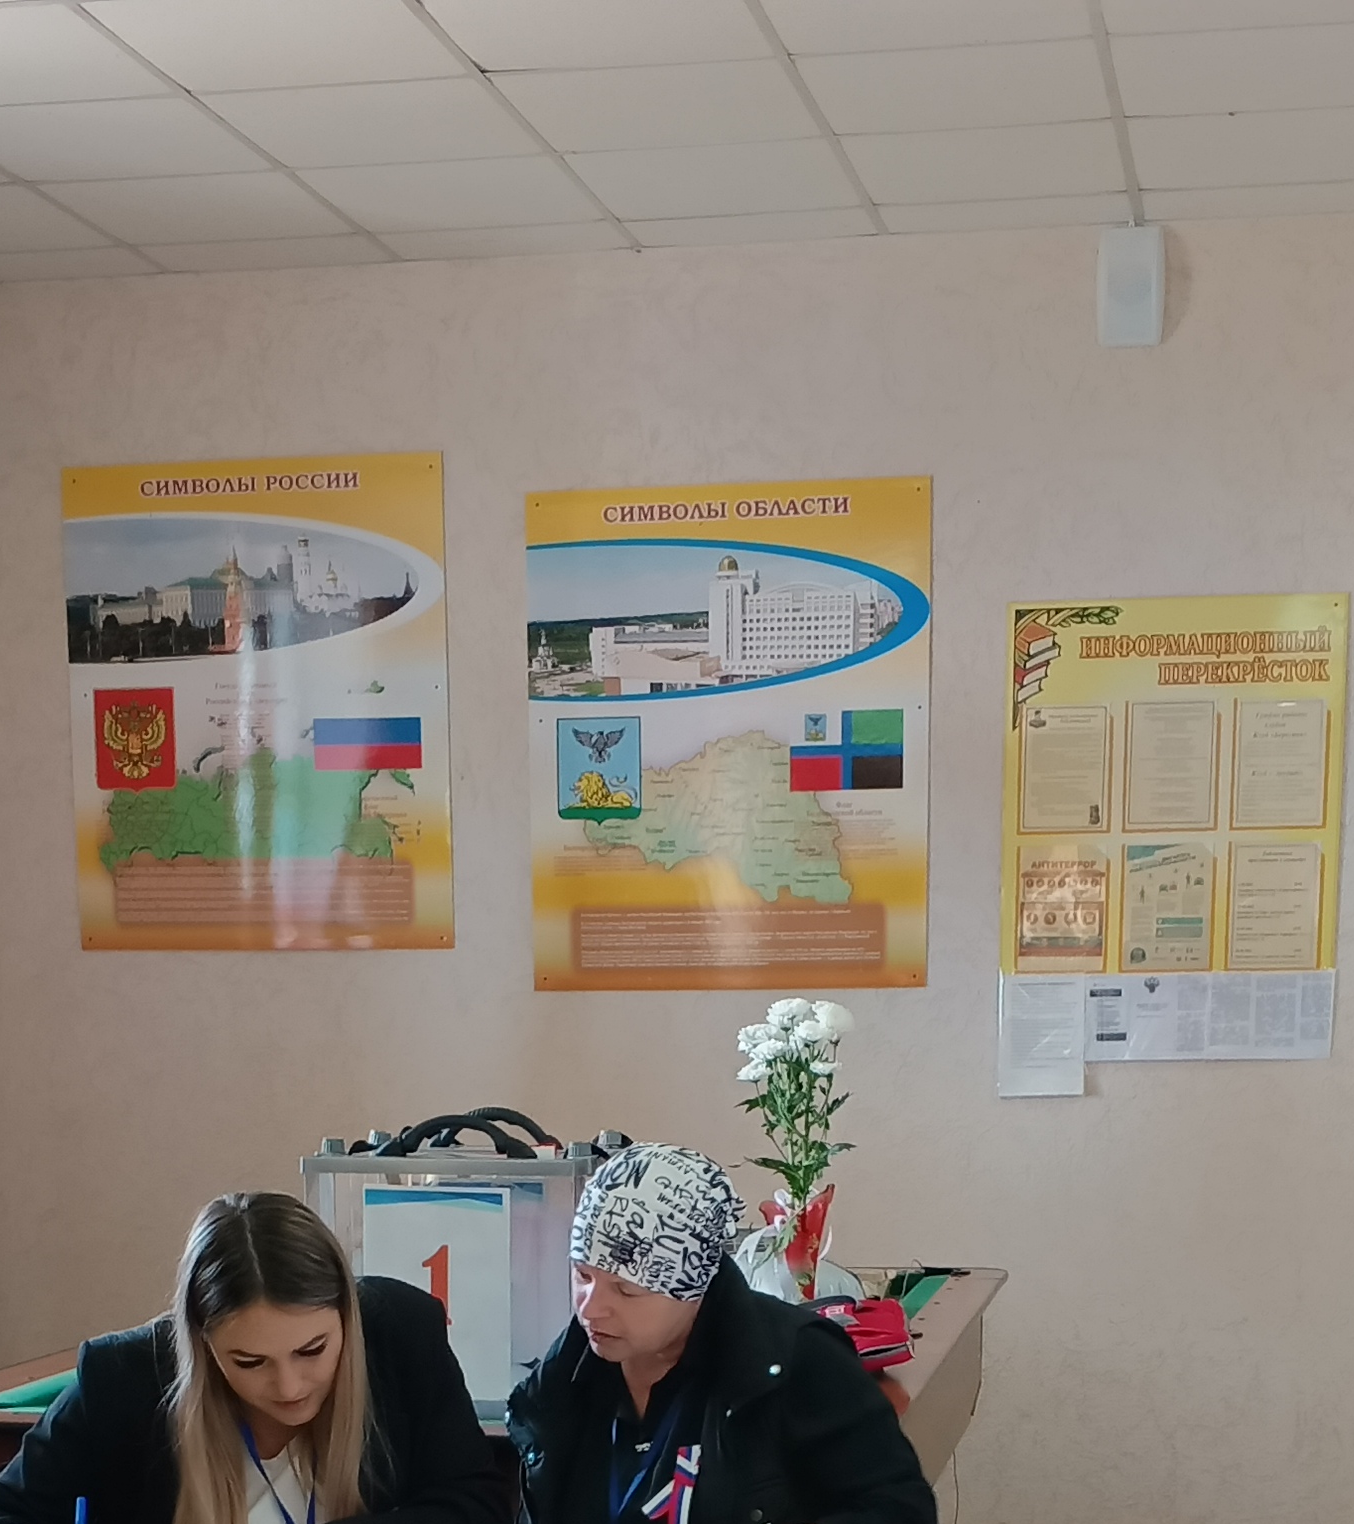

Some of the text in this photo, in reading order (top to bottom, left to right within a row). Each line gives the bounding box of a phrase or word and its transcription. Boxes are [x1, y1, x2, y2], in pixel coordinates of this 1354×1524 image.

[140, 472, 359, 497] СИМВОЛЫ РОССИИ
[603, 496, 850, 524] СИМВОЛЫ ОБЛАСТИ
[1079, 626, 1332, 659] ИНФОРМАЦИОННЫЙ
[1158, 657, 1330, 685] ПЕРЕКРЁСТОК
[1031, 860, 1097, 869] АНТИТЕРРОР
[422, 1244, 453, 1326] 1
